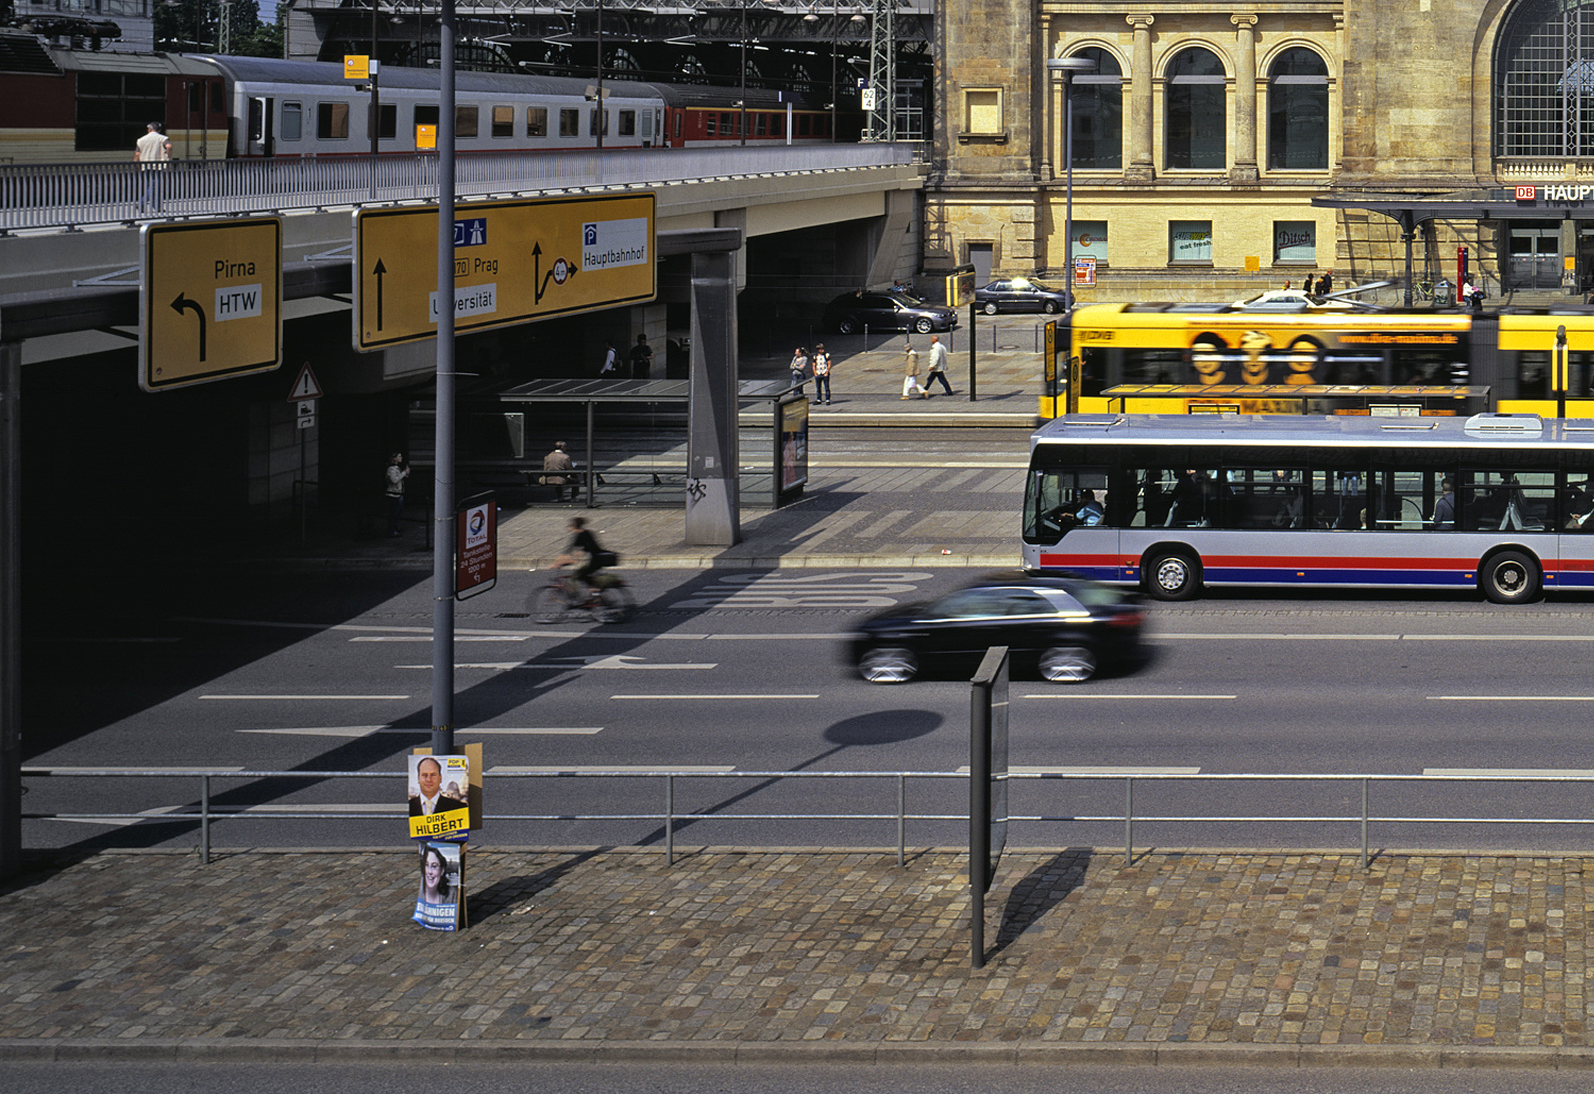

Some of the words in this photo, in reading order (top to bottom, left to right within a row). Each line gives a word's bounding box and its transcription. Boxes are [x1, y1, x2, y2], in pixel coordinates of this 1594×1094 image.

[1180, 242, 1192, 250] eat
[1193, 239, 1212, 248] fresh
[1279, 230, 1311, 246] Ditsch
[584, 245, 645, 268] Hauptbahnhof
[215, 259, 256, 279] Pirna
[474, 257, 498, 275] Prag
[220, 291, 257, 314] HTW
[433, 291, 493, 315] Uversität
[467, 535, 487, 544] TOTAL
[460, 560, 469, 569] 24
[469, 551, 492, 566] Stunden
[462, 543, 491, 559] Tankstelle
[468, 564, 480, 574] 1200
[667, 572, 934, 608] BUS
[416, 818, 464, 836] HILBERT
[426, 813, 447, 824] DIRK
